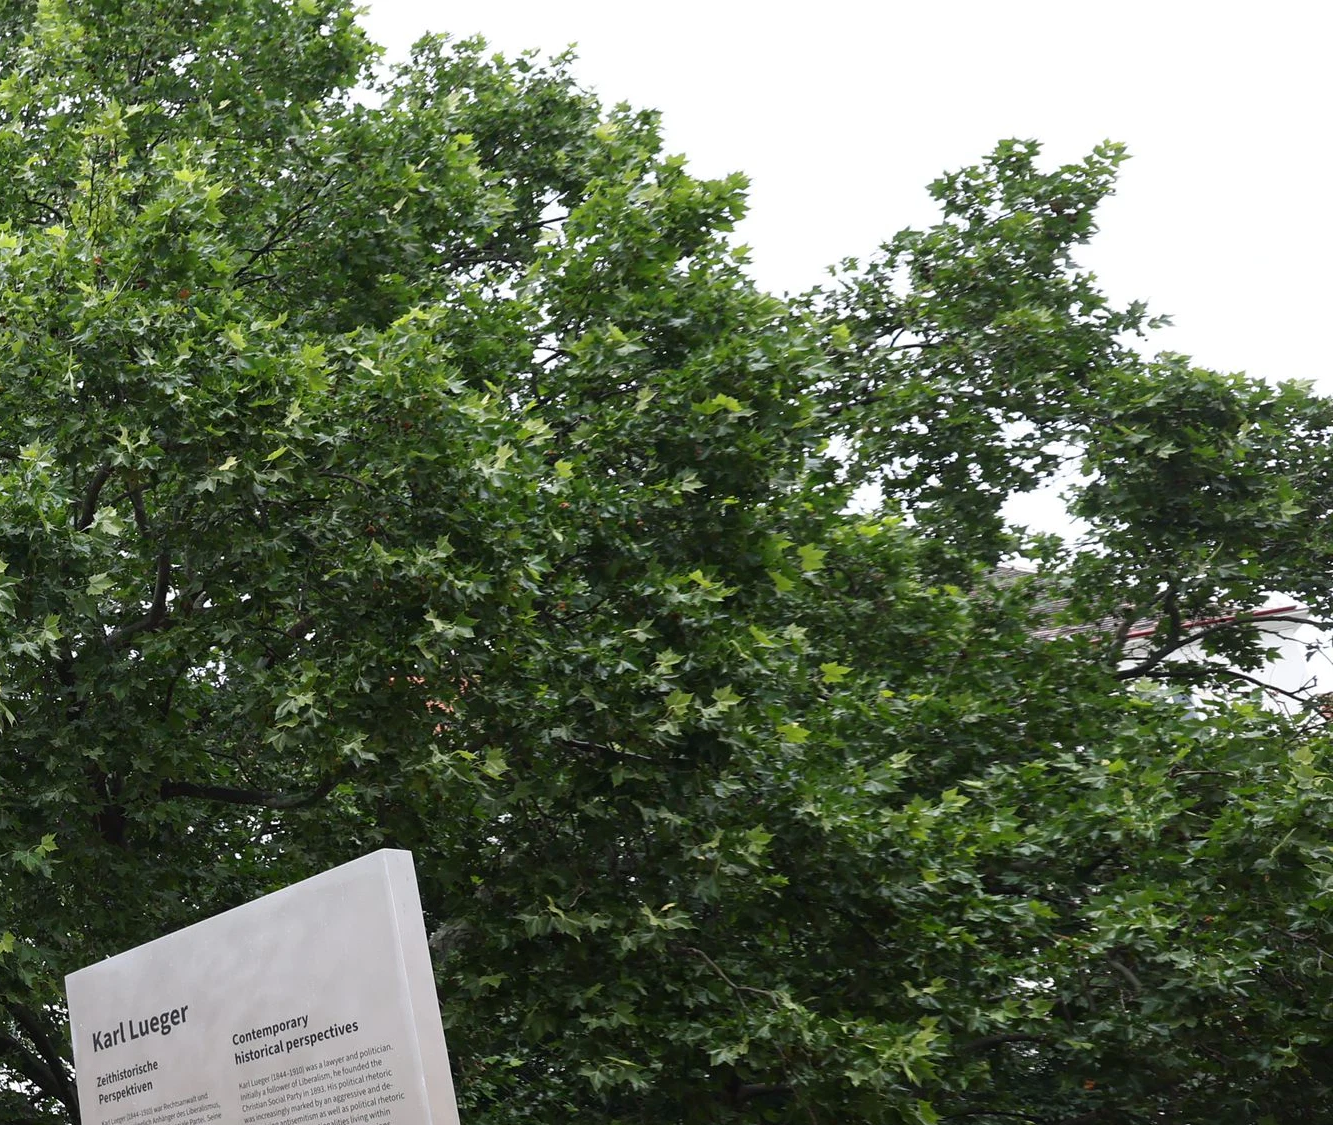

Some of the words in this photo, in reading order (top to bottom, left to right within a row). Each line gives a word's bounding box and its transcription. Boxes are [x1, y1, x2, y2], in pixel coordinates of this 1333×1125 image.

[92, 1021, 125, 1052] Karl
[129, 1005, 187, 1039] Lueger
[232, 1015, 307, 1045] Contemporary
[234, 1039, 283, 1064] historical
[286, 1021, 358, 1053] perspectives
[96, 1060, 157, 1087] Zeithistorische
[238, 1079, 250, 1090] Karl
[250, 1076, 270, 1086] Lueger
[305, 1063, 317, 1072] was
[323, 1056, 345, 1067] lawyer
[345, 1050, 358, 1061] and
[240, 1089, 261, 1101] Initially
[266, 1082, 290, 1094] follower
[290, 1079, 297, 1088] of
[332, 1068, 341, 1077] he
[341, 1060, 369, 1075] founded
[370, 1057, 382, 1067] the
[241, 1100, 267, 1112] Christian
[267, 1094, 286, 1106] Social
[286, 1091, 302, 1101] Party
[302, 1089, 309, 1097] in
[326, 1082, 337, 1091] His
[337, 1074, 364, 1090] political
[365, 1068, 392, 1081] rhetoric
[98, 1081, 152, 1104] Perspektiven
[243, 1115, 255, 1124] was
[255, 1106, 290, 1121] increasingly
[290, 1099, 314, 1112] marked
[314, 1098, 323, 1107] by
[323, 1096, 332, 1104] an
[332, 1088, 366, 1103] aggressive
[366, 1082, 380, 1094] and
[318, 1110, 327, 1118] as
[326, 1105, 340, 1116] well
[349, 1096, 376, 1112] political
[377, 1091, 404, 1104] rhetoric
[349, 1113, 368, 1123] living
[368, 1107, 390, 1119] within
